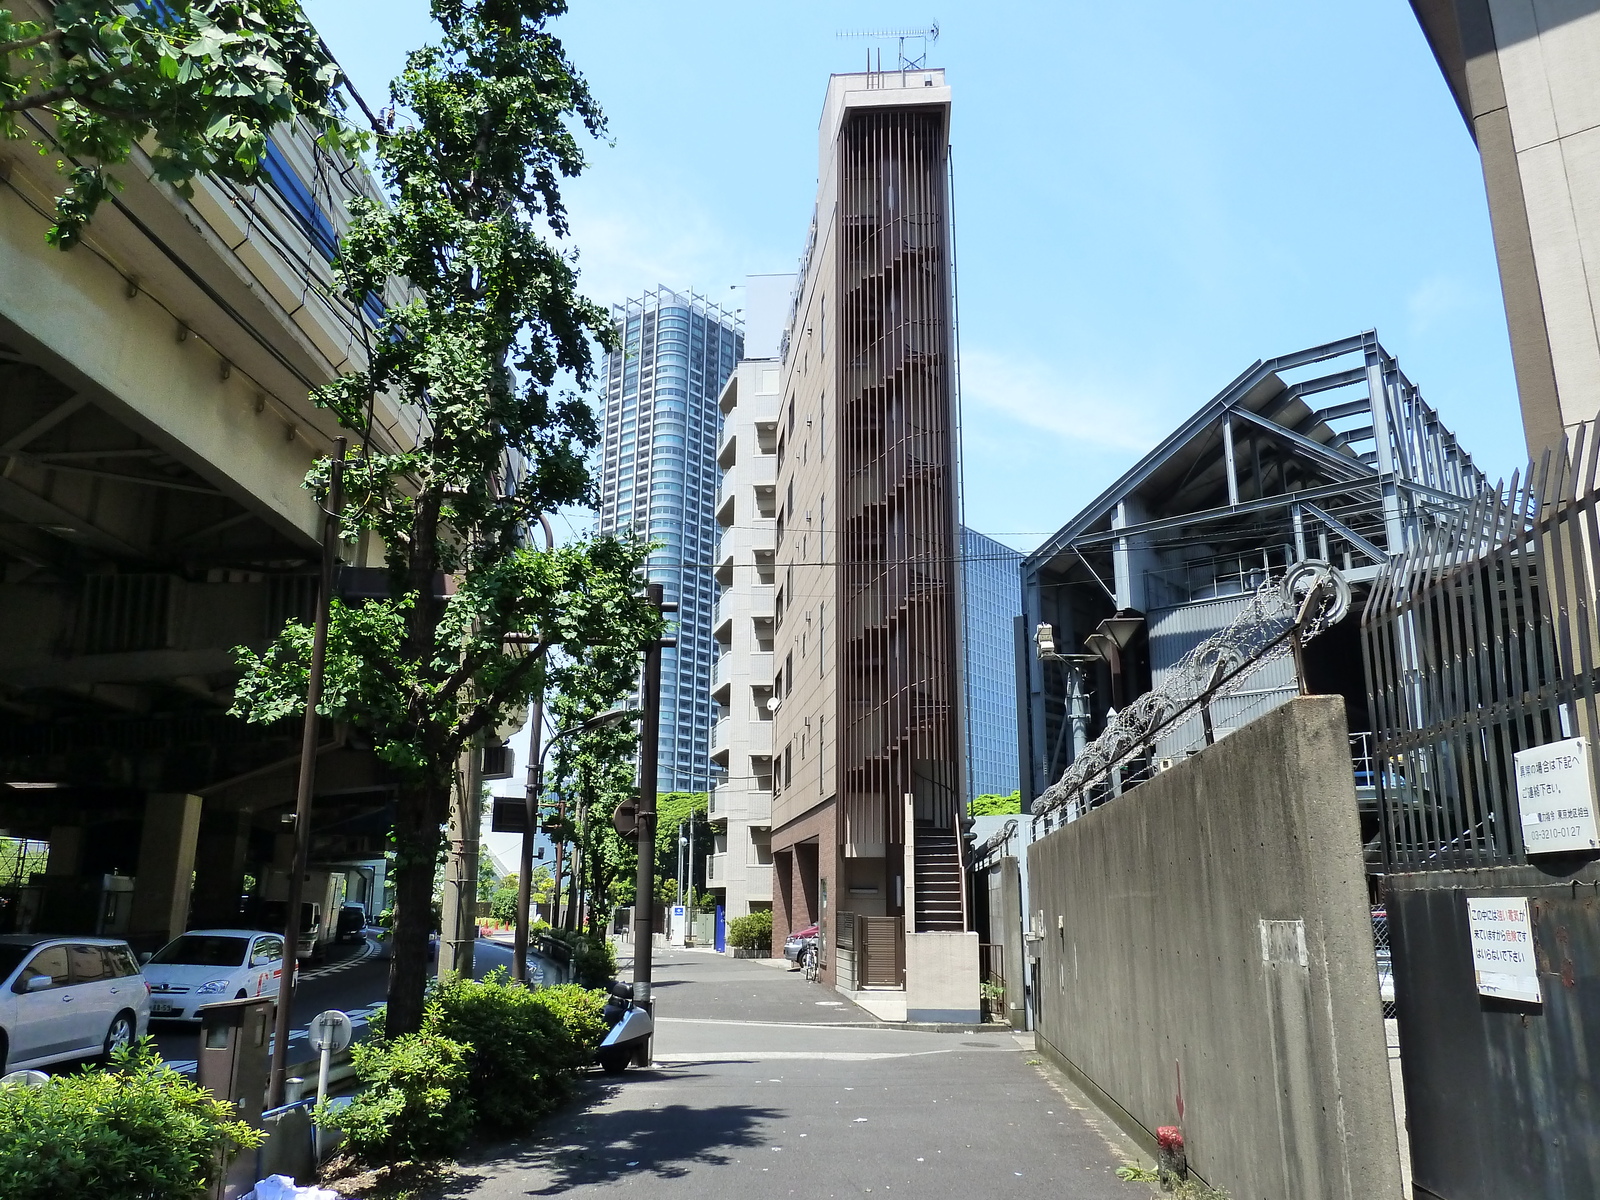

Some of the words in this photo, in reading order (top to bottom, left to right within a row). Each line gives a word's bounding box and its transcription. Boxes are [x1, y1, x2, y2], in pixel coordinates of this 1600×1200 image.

[1531, 825, 1581, 841] 03-3210-0127
[1476, 948, 1526, 963] はいらないで下さい
